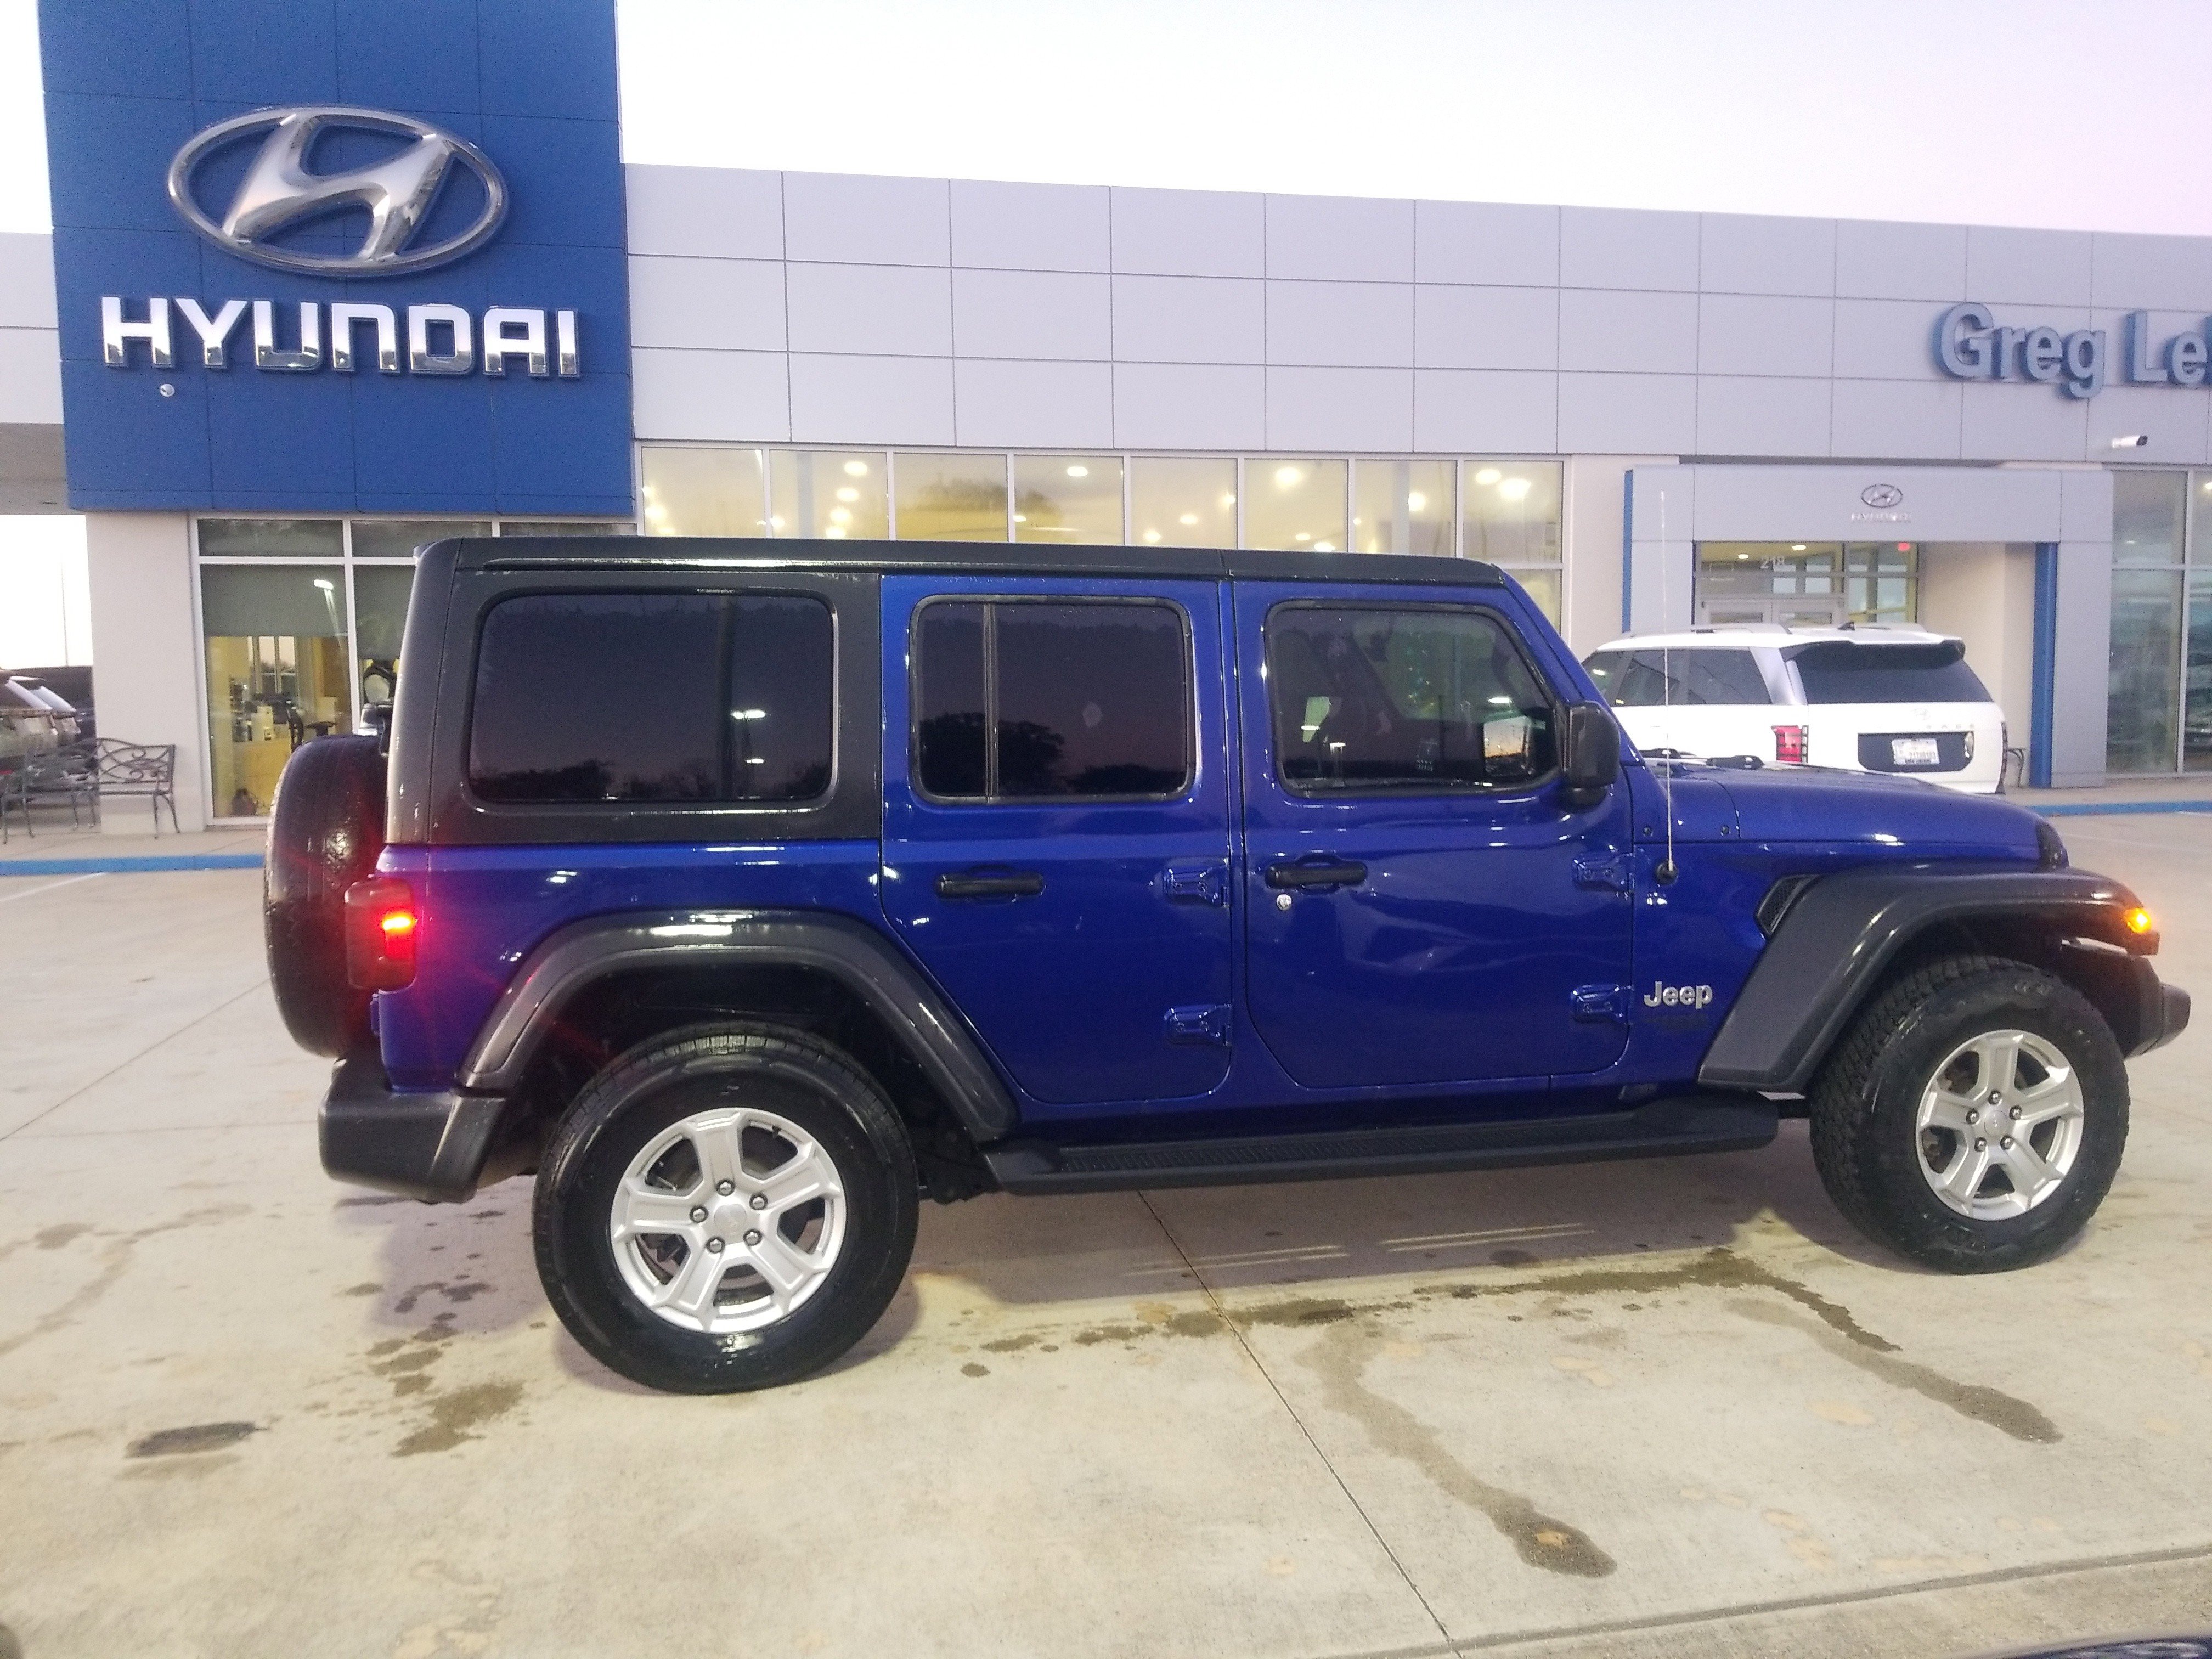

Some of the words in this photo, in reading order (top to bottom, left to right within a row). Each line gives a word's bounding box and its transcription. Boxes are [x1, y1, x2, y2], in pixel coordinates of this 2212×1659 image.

[101, 295, 580, 379] HYUNDAI
[1933, 302, 2105, 399] Greg
[2126, 309, 2212, 388] Le
[1644, 981, 1713, 1009] Jeep
